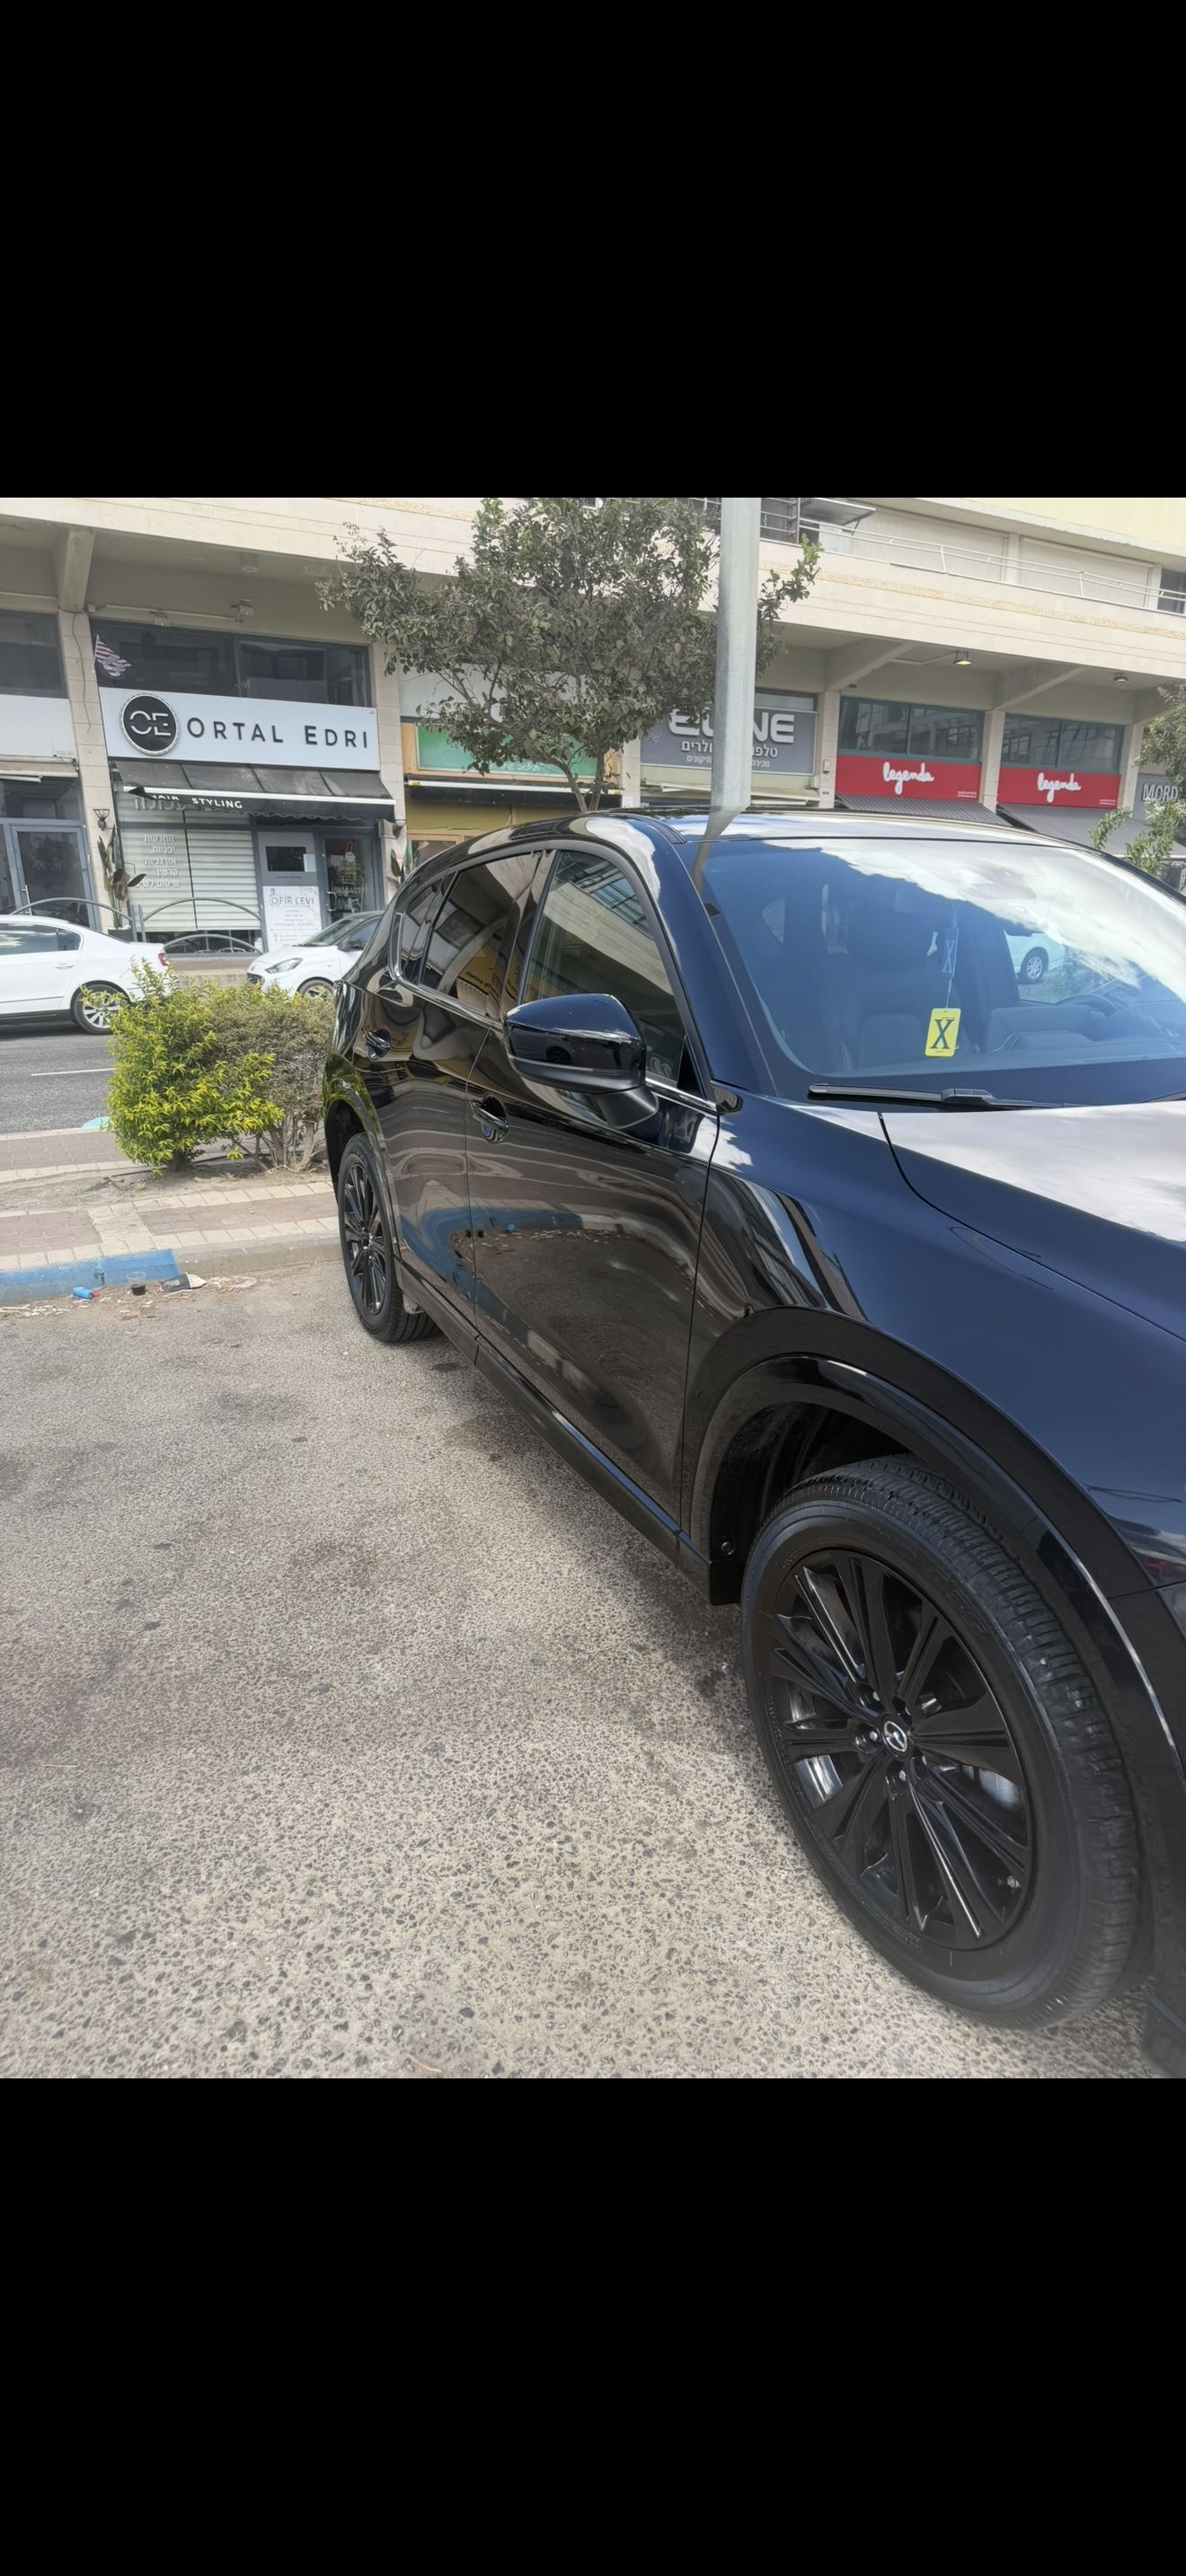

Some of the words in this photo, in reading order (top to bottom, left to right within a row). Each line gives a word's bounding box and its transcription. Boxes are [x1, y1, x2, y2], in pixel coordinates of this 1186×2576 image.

[187, 717, 283, 743] ORTAL
[305, 725, 367, 747] EDRI
[882, 762, 934, 794] legenda
[1037, 772, 1082, 803] legenda
[191, 798, 243, 809] STYLING
[295, 896, 314, 905] LEVI
[930, 1019, 955, 1049] X
